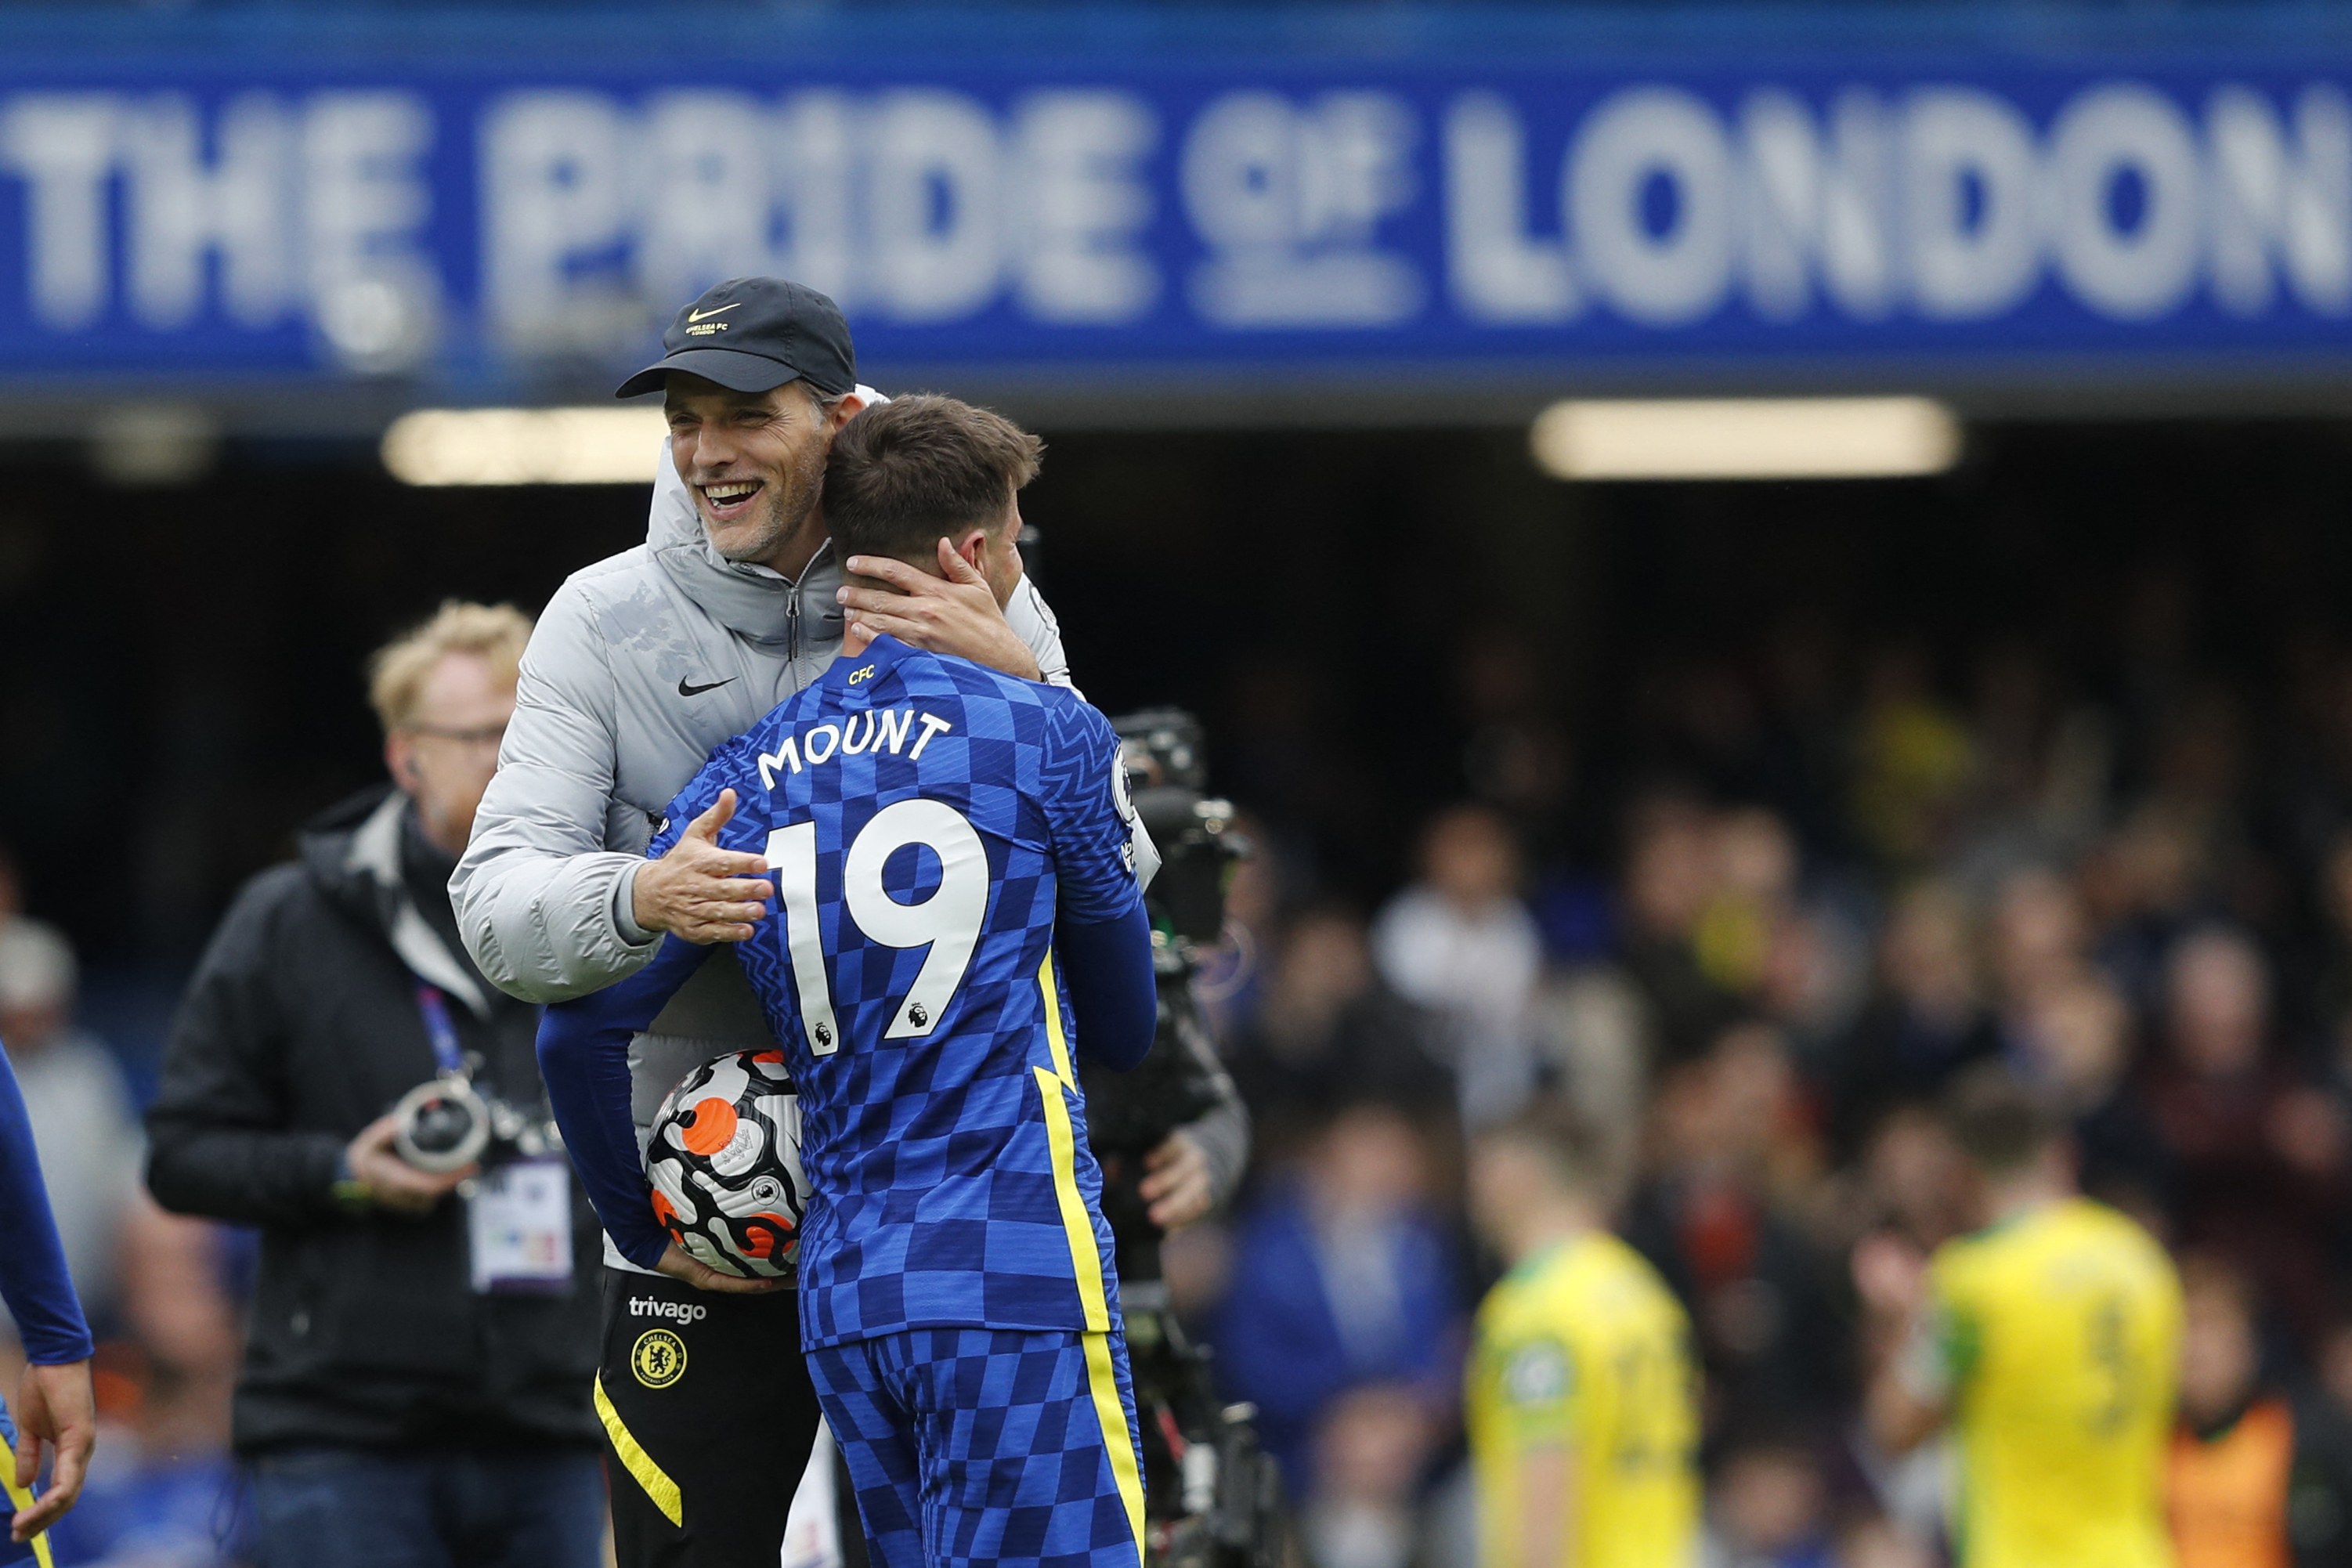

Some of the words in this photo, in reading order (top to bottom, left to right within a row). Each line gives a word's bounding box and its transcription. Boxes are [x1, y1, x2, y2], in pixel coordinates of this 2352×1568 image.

[3, 89, 442, 329] THE
[484, 88, 1155, 335] PRIDE
[1181, 86, 1414, 252] OF
[1443, 80, 2352, 327] LONDON
[685, 323, 716, 334] CHELSEA
[848, 663, 875, 685] CFC
[757, 709, 952, 791] MOUNT
[763, 797, 991, 1057] 19
[629, 1295, 707, 1325] trivago
[643, 1334, 677, 1347] CHELSEA
